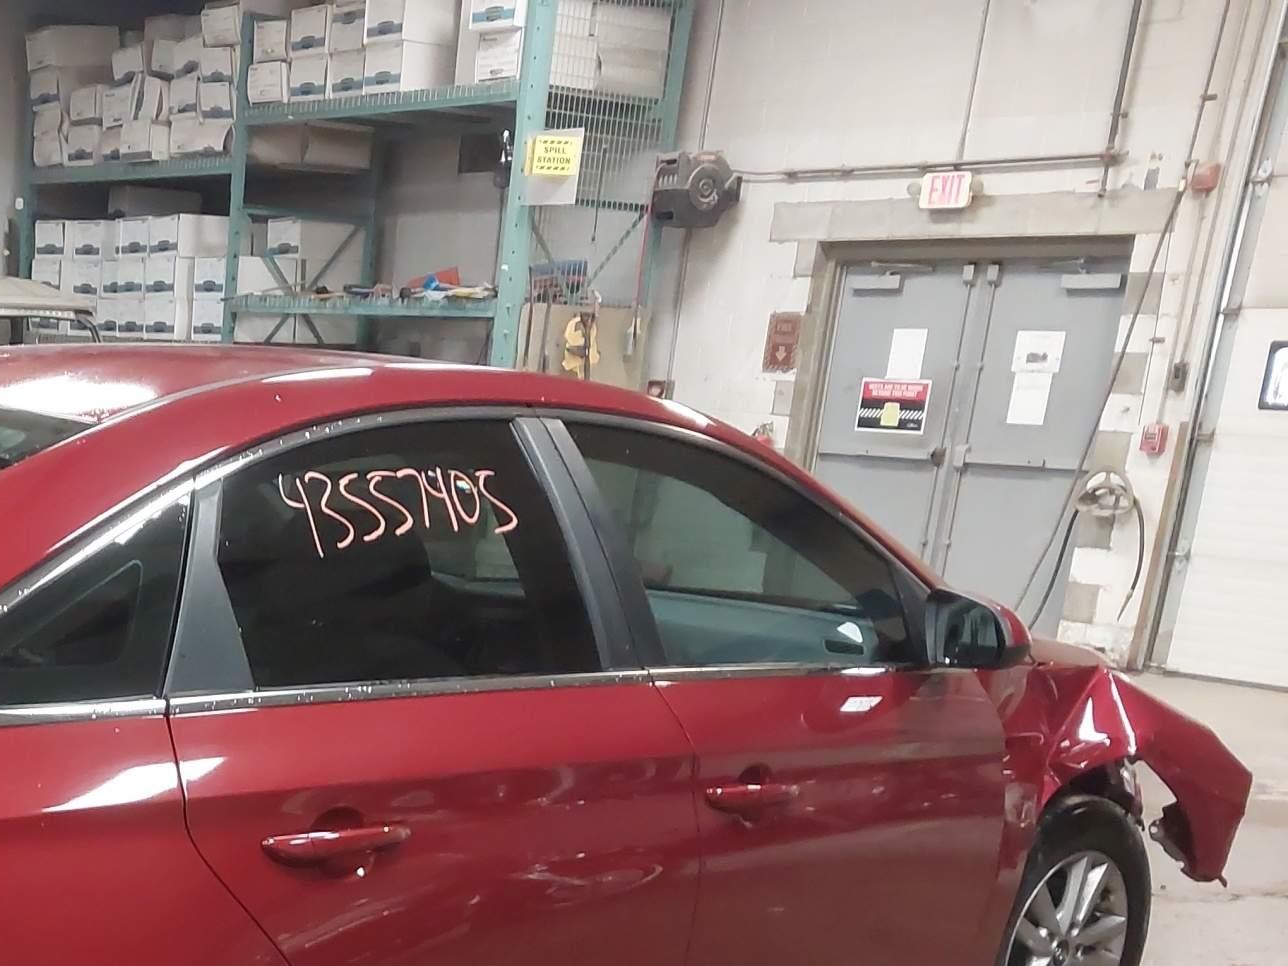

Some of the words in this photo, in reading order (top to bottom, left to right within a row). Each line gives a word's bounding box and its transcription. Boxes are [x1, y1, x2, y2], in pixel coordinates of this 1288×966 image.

[544, 146, 566, 154] SPILL
[537, 156, 571, 165] STATION
[927, 174, 966, 206] EXIT
[278, 466, 519, 558] 43557405
